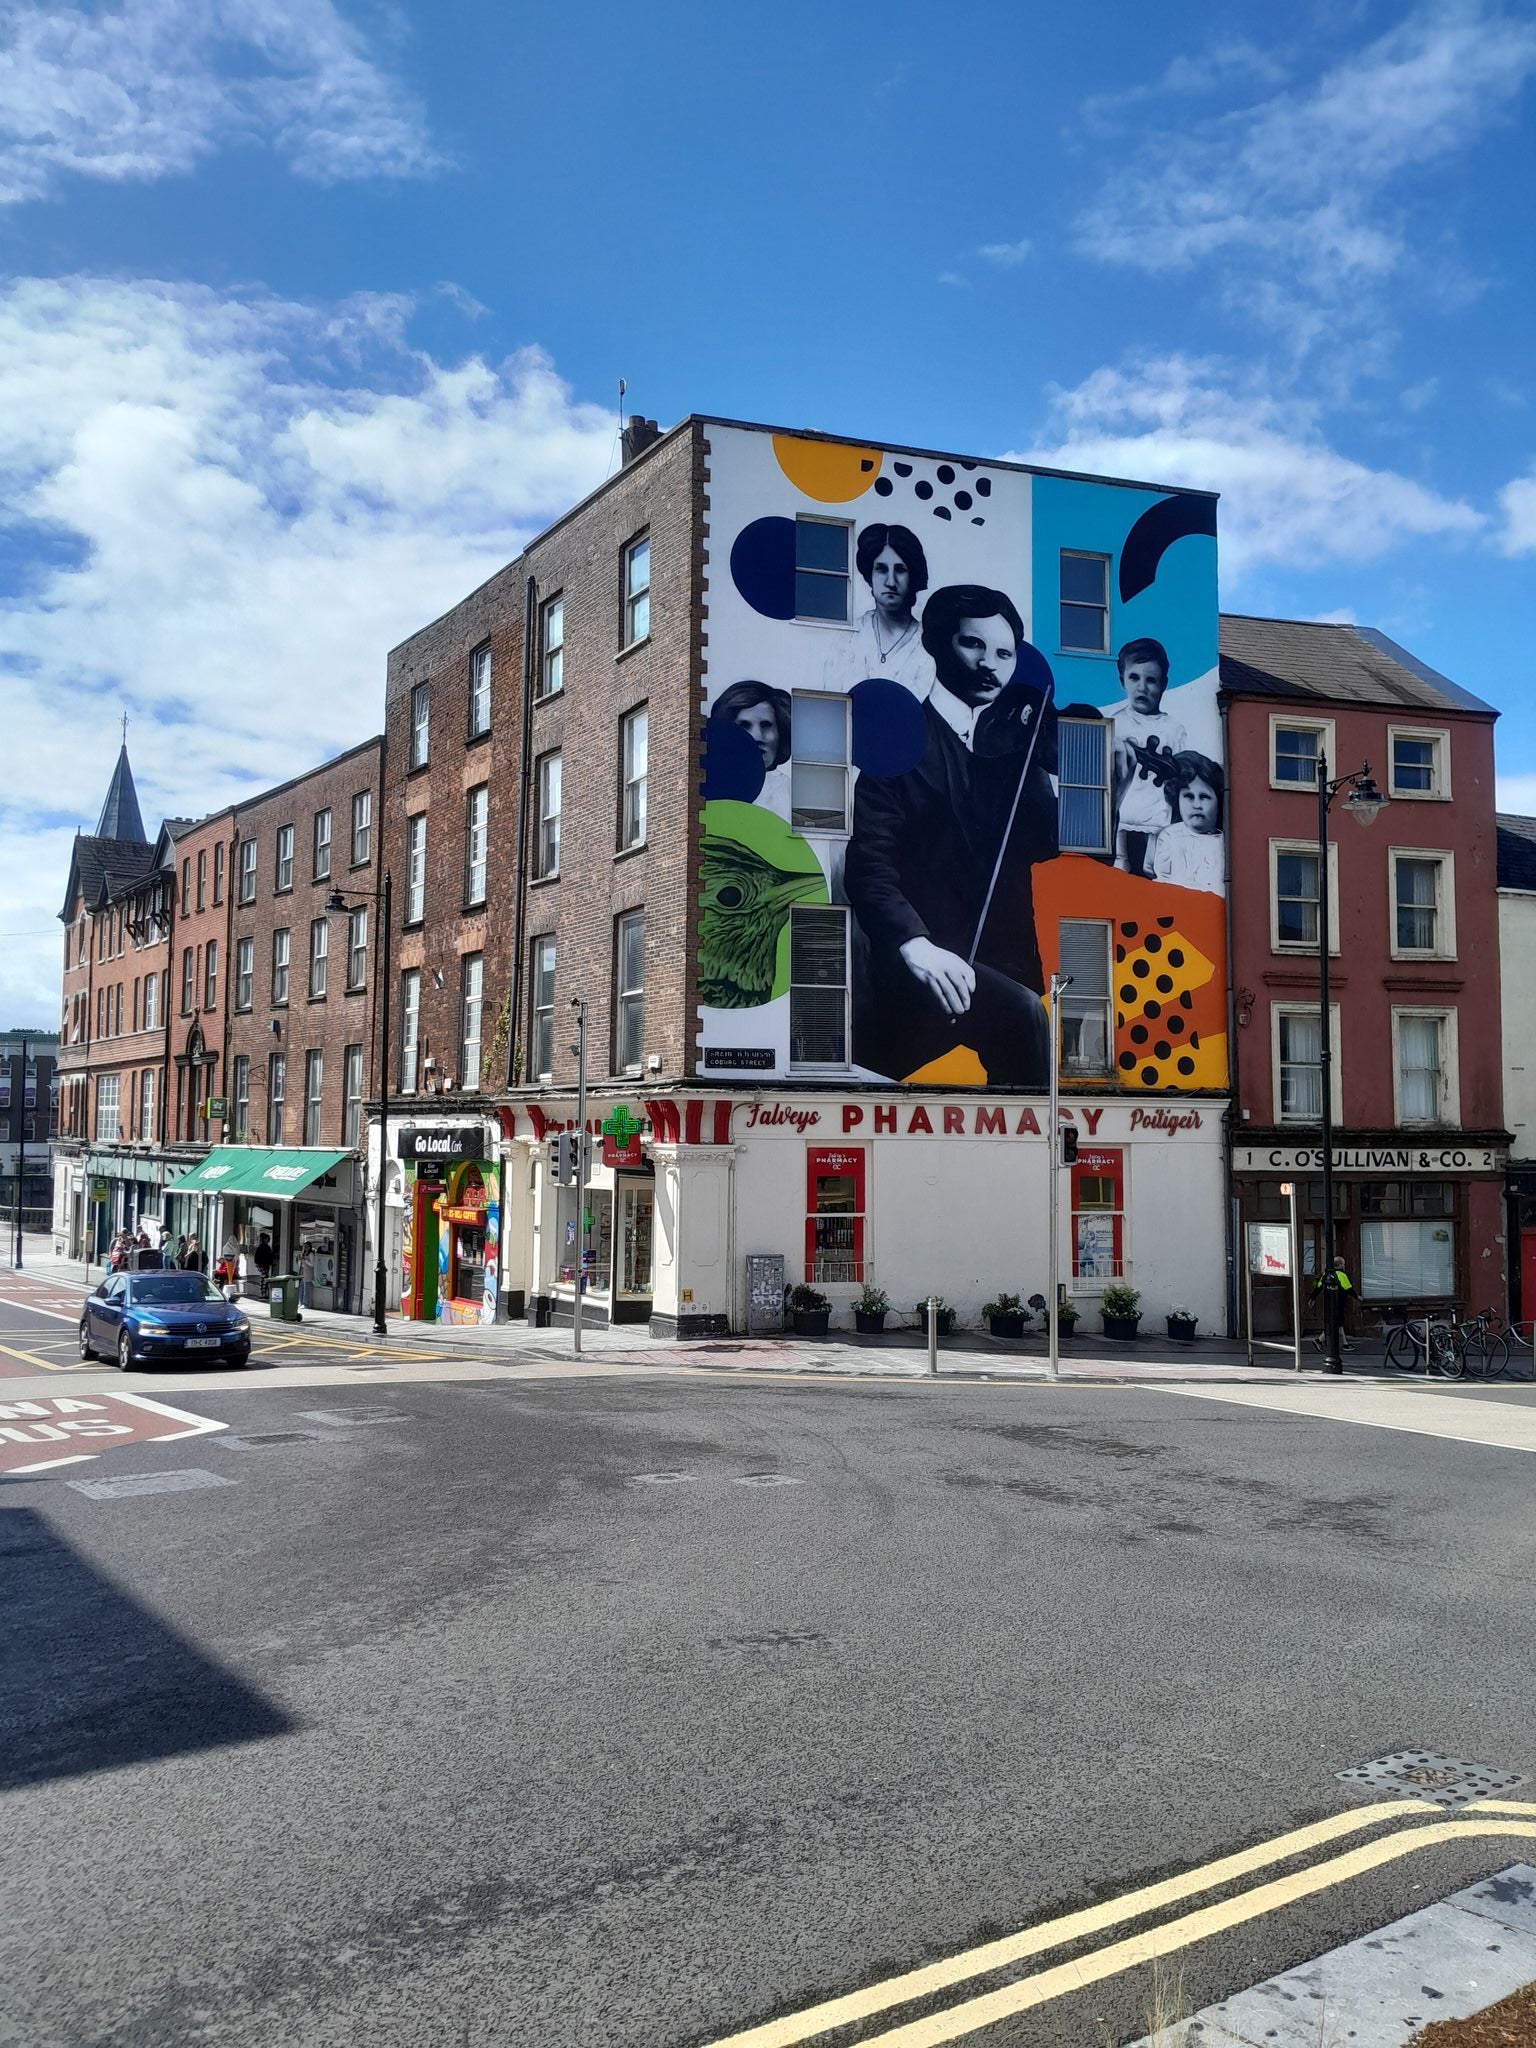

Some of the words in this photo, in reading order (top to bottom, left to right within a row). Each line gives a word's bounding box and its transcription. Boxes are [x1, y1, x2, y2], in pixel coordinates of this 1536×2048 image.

[415, 1136, 426, 1152] Go
[427, 1134, 450, 1152] Local
[1246, 1151, 1252, 1165] 1
[1269, 1151, 1290, 1166] C.
[1295, 1149, 1409, 1167] O'SULLIVAN
[1419, 1152, 1430, 1168] &
[1440, 1151, 1472, 1167] CO.
[1482, 1152, 1491, 1165] 2
[683, 1290, 692, 1301] H
[0, 1419, 135, 1444] US
